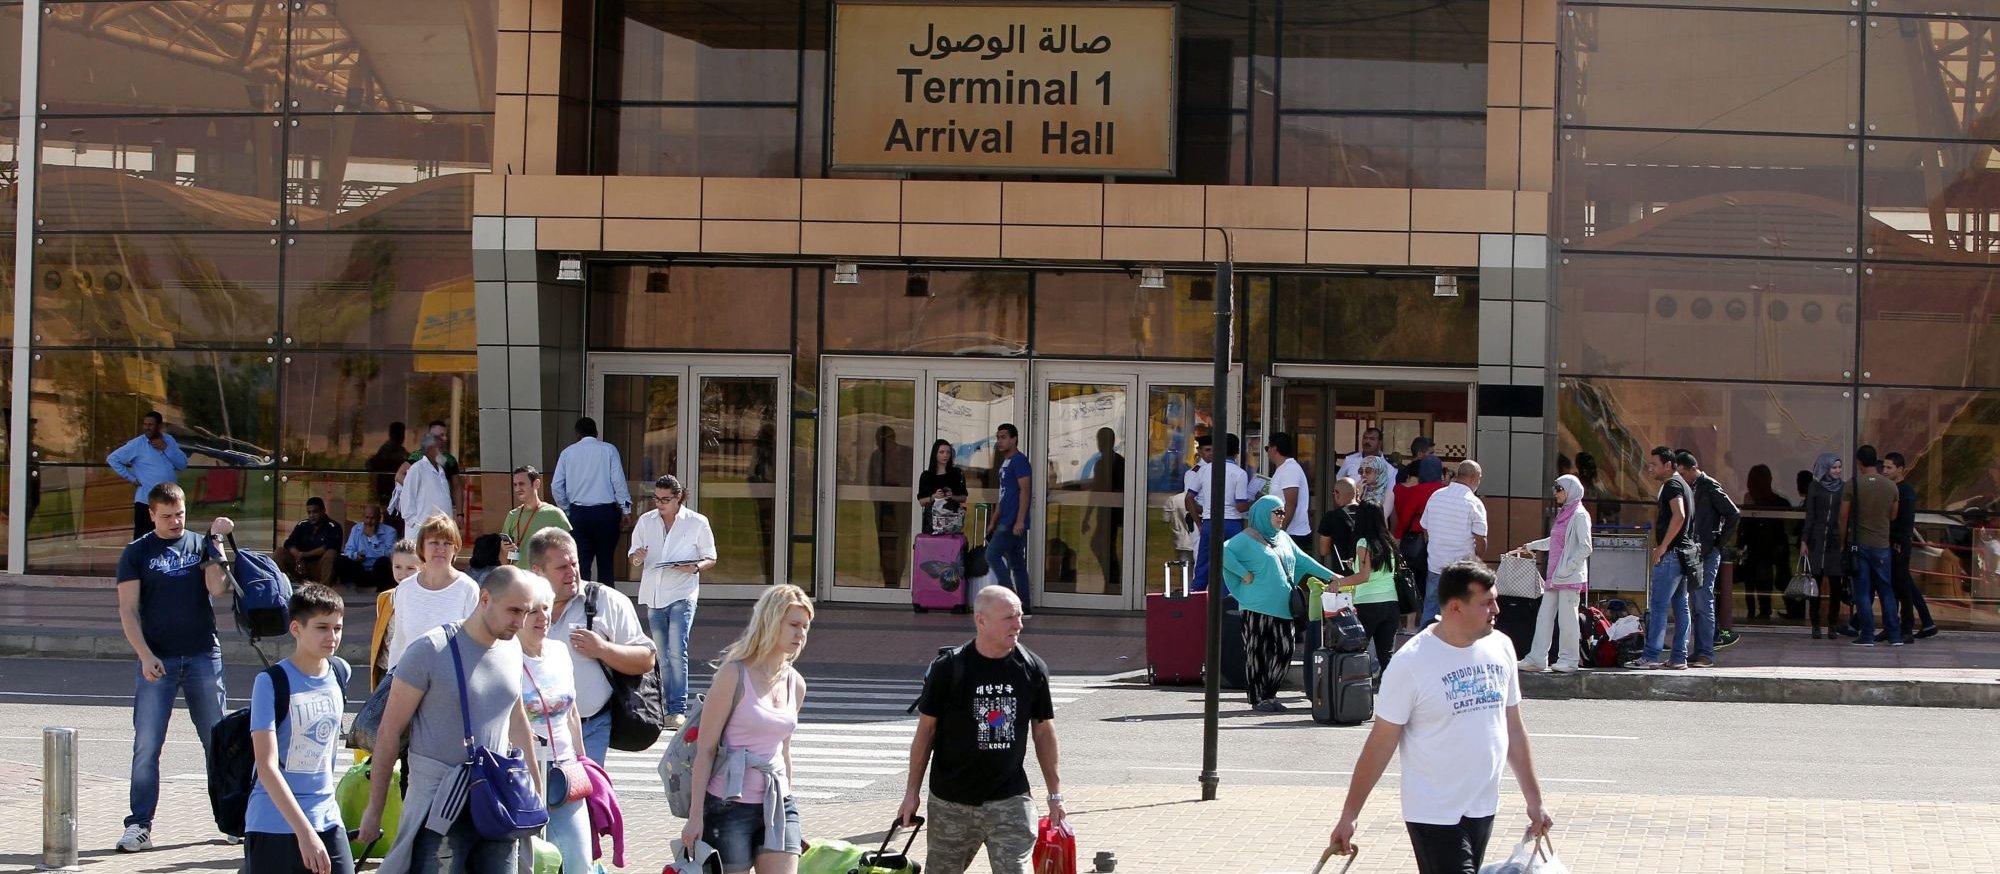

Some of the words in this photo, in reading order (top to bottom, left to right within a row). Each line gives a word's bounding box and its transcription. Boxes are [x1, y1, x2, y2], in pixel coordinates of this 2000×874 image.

[909, 23, 1025, 60] الوصول
[1038, 24, 1112, 54] صالة
[896, 68, 1078, 105] Terminal
[1095, 70, 1112, 106] 1
[884, 118, 1013, 153] Arrival
[1041, 120, 1114, 155] Hall
[976, 684, 1014, 695] 대한민국
[1453, 698, 1474, 710] CAST
[988, 742, 1011, 750] KOREA
